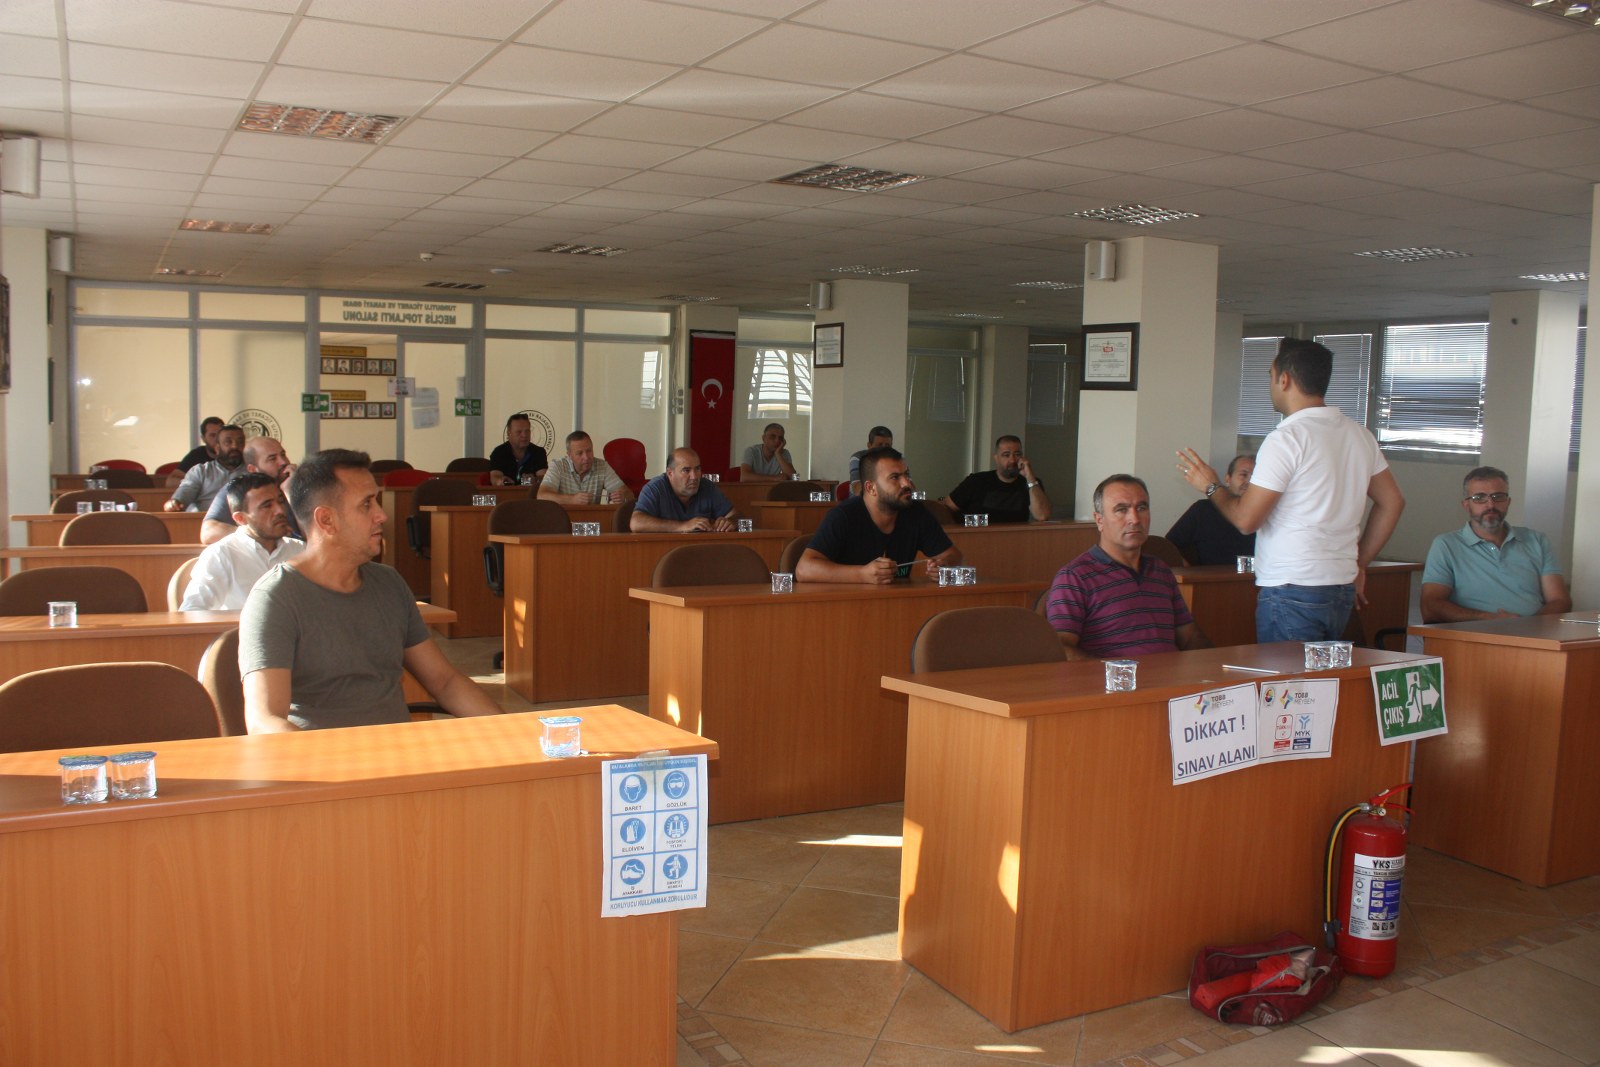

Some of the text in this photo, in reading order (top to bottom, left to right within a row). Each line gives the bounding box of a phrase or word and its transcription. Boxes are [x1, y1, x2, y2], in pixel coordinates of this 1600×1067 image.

[1211, 694, 1226, 702] TOBB
[1382, 678, 1399, 701] ACİL
[1383, 705, 1404, 730] ÇIKIŞ
[1184, 716, 1237, 743] DİKKAT
[1177, 754, 1215, 777] SINAV
[1218, 745, 1255, 767] ALANI
[622, 845, 645, 853] ELDİVEN
[1372, 859, 1391, 869] YKS
[610, 899, 638, 910] KORUYUCU
[638, 896, 668, 906] KULLANMAK
